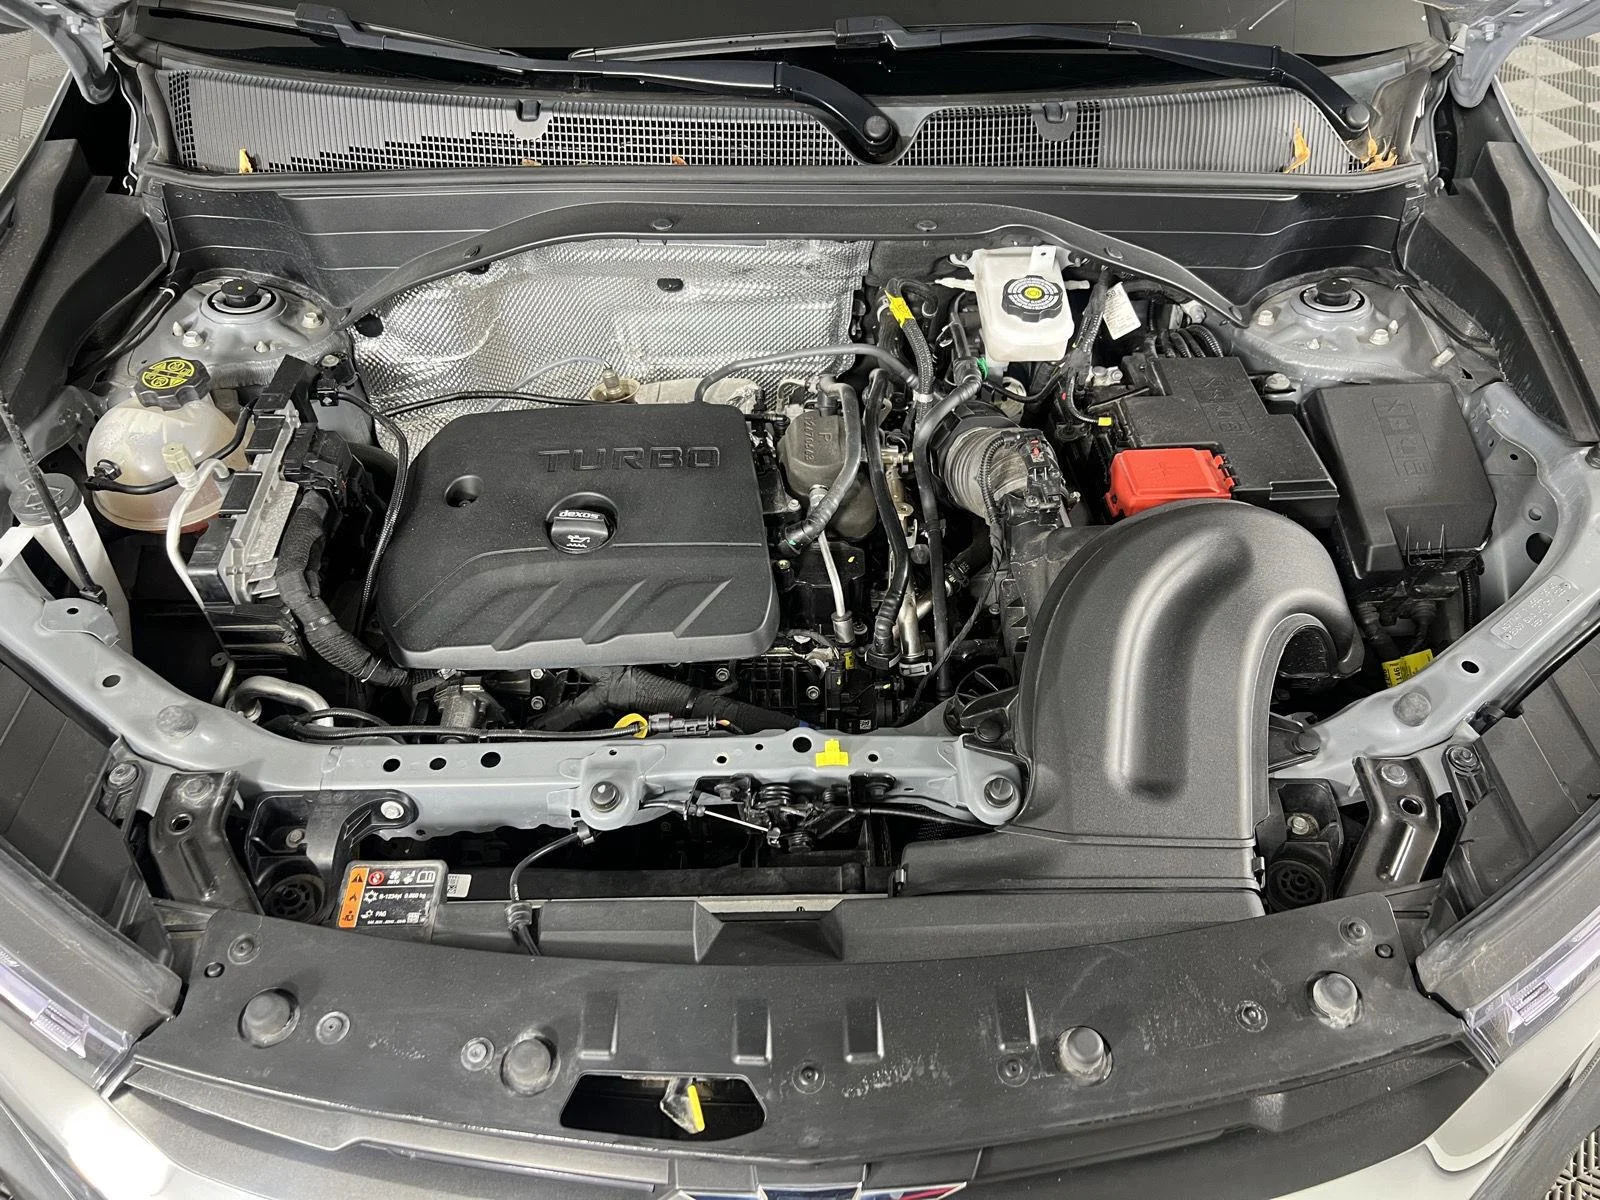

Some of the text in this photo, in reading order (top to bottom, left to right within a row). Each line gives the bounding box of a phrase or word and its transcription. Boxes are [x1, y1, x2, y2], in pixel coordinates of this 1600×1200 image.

[818, 432, 832, 442] P
[537, 446, 721, 473] TURBO
[558, 509, 601, 520] dexos
